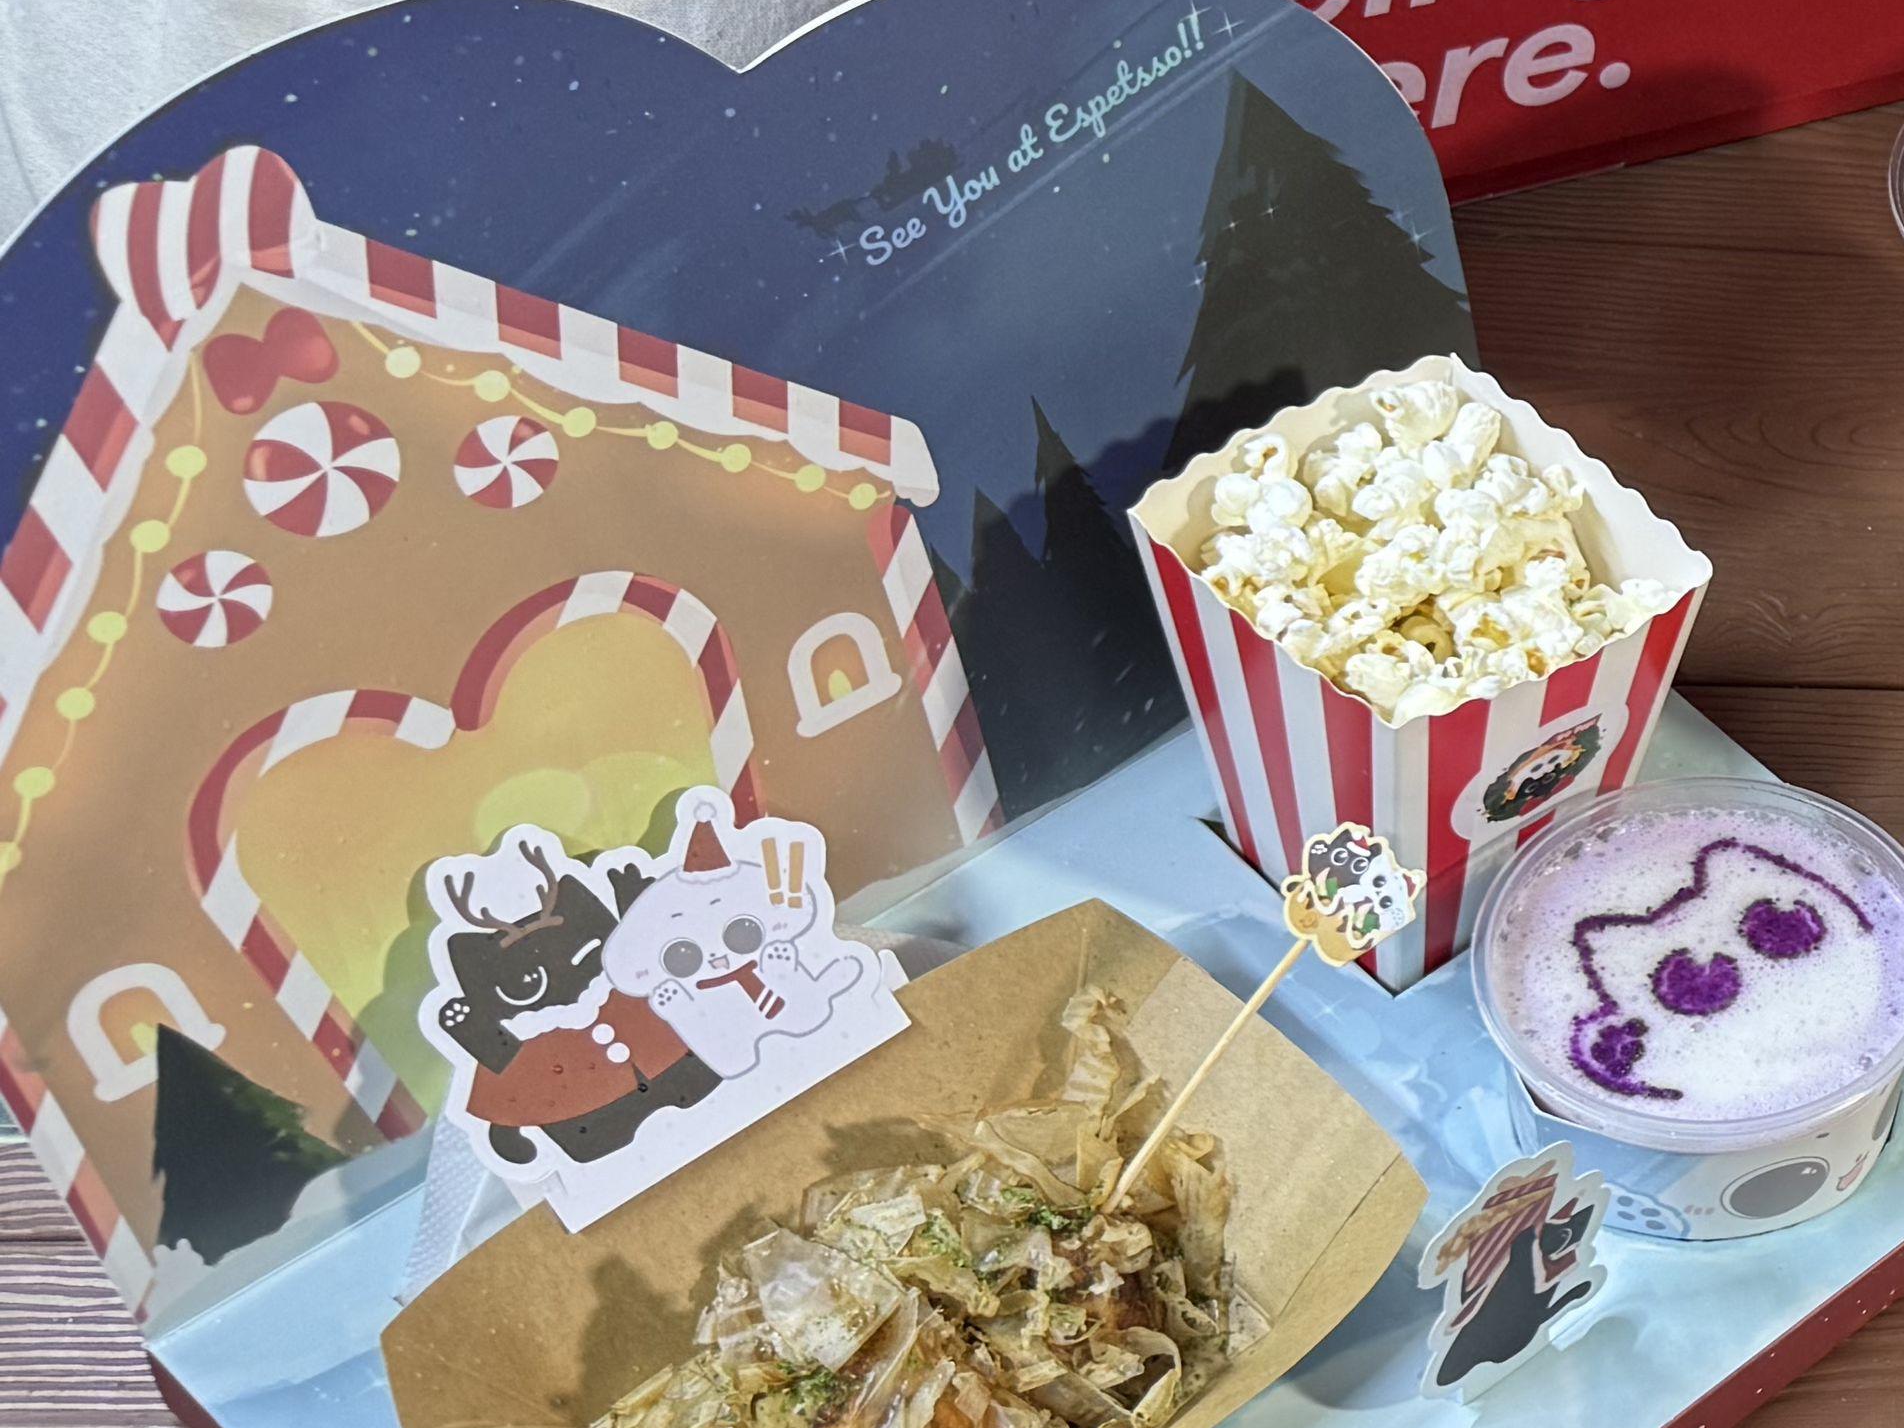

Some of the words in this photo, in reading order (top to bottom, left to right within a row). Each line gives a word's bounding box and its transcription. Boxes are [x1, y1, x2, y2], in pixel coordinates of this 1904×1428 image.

[859, 217, 926, 266] See
[922, 166, 1000, 228] You
[1008, 123, 1043, 172] at
